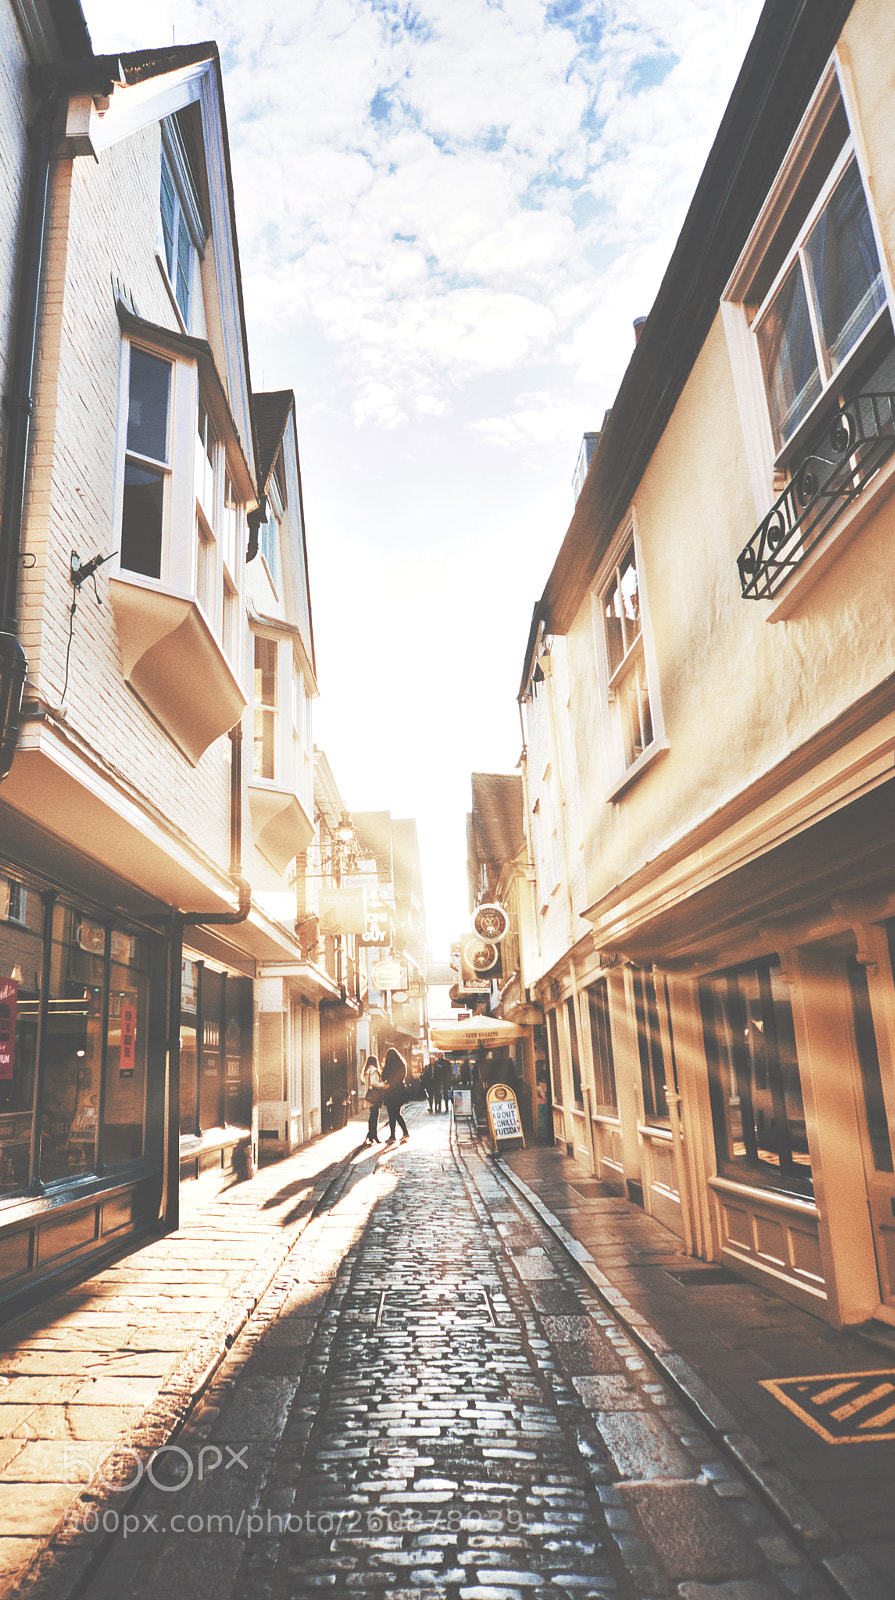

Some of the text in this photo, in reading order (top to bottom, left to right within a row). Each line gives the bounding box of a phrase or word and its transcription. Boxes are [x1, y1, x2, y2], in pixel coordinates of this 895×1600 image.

[367, 912, 388, 923] ONI
[361, 930, 387, 942] GUY
[507, 1102, 516, 1110] US
[492, 1110, 515, 1119] ABOUT
[496, 1118, 516, 1127] CHILLI
[495, 1126, 521, 1136] TUESDAY
